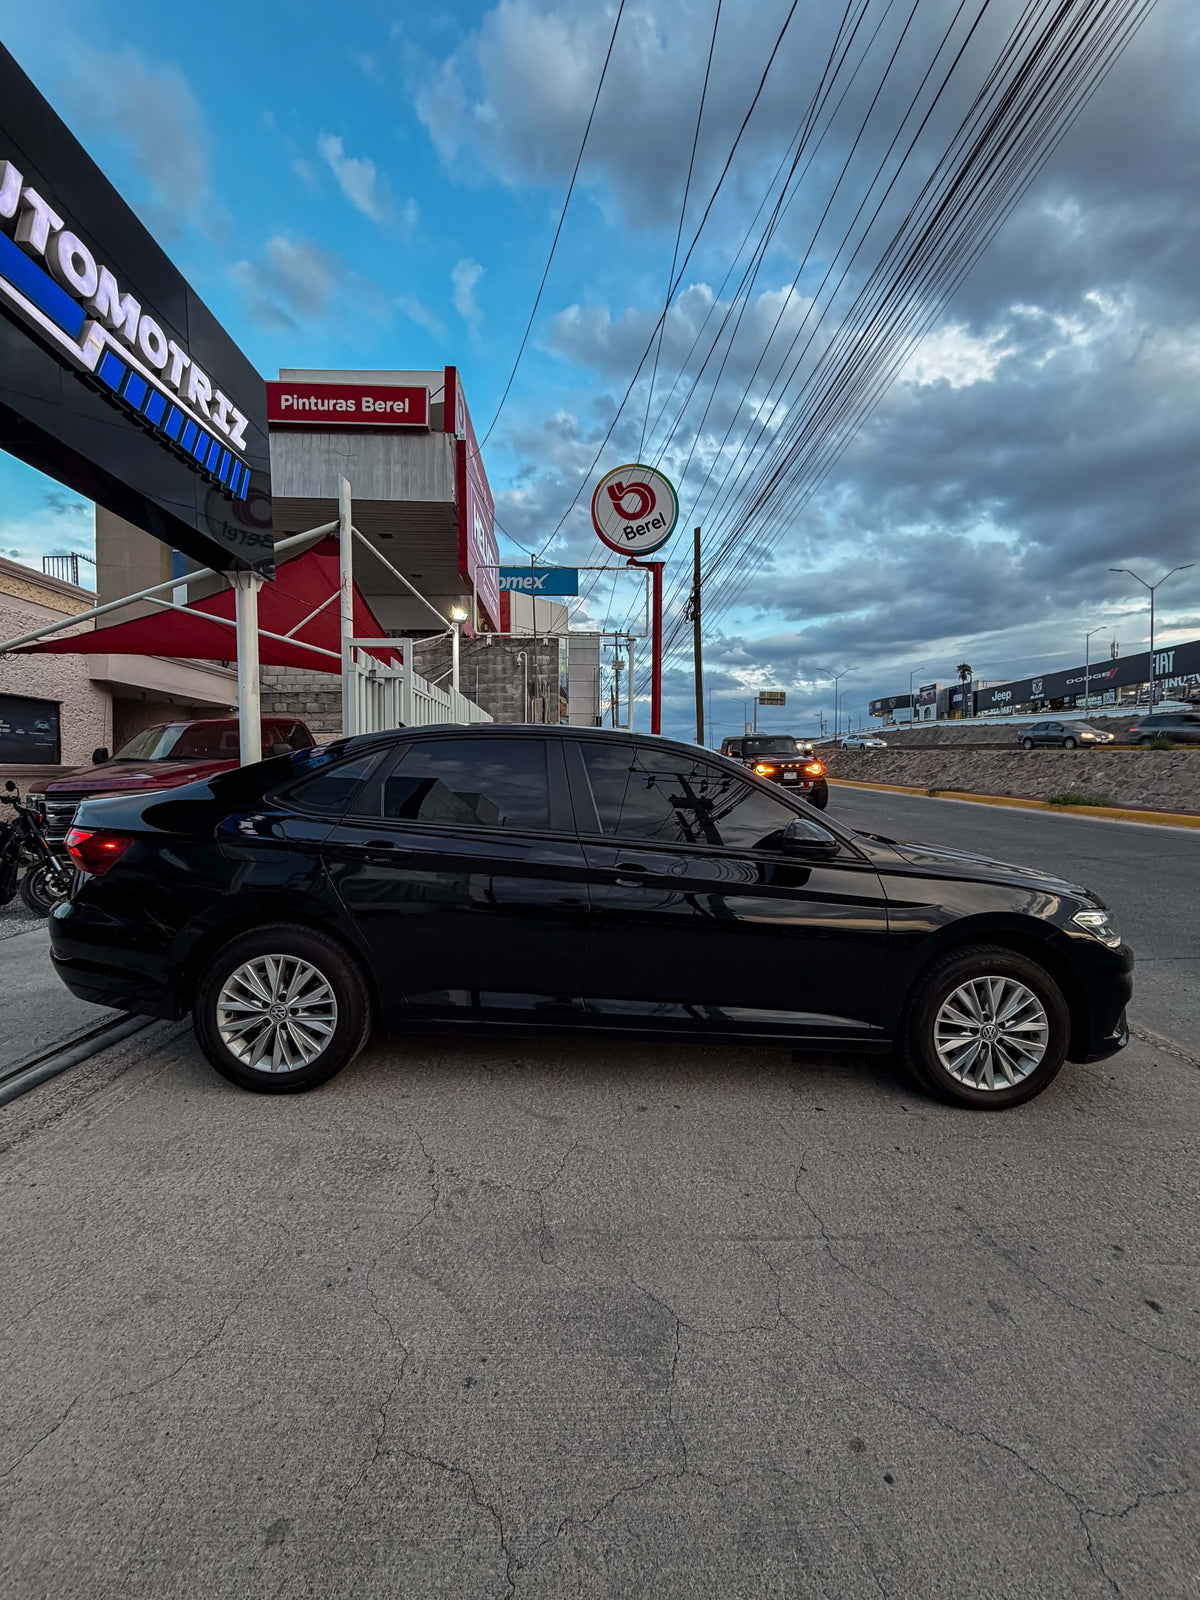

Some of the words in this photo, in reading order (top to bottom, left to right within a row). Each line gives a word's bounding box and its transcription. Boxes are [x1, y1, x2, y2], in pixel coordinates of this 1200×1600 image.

[280, 394, 356, 411] Pinturas
[361, 397, 410, 413] Berel
[622, 511, 667, 541] Berel
[1152, 650, 1176, 675] IAT
[1066, 671, 1111, 685] DODGE
[991, 690, 1012, 702] Jeep
